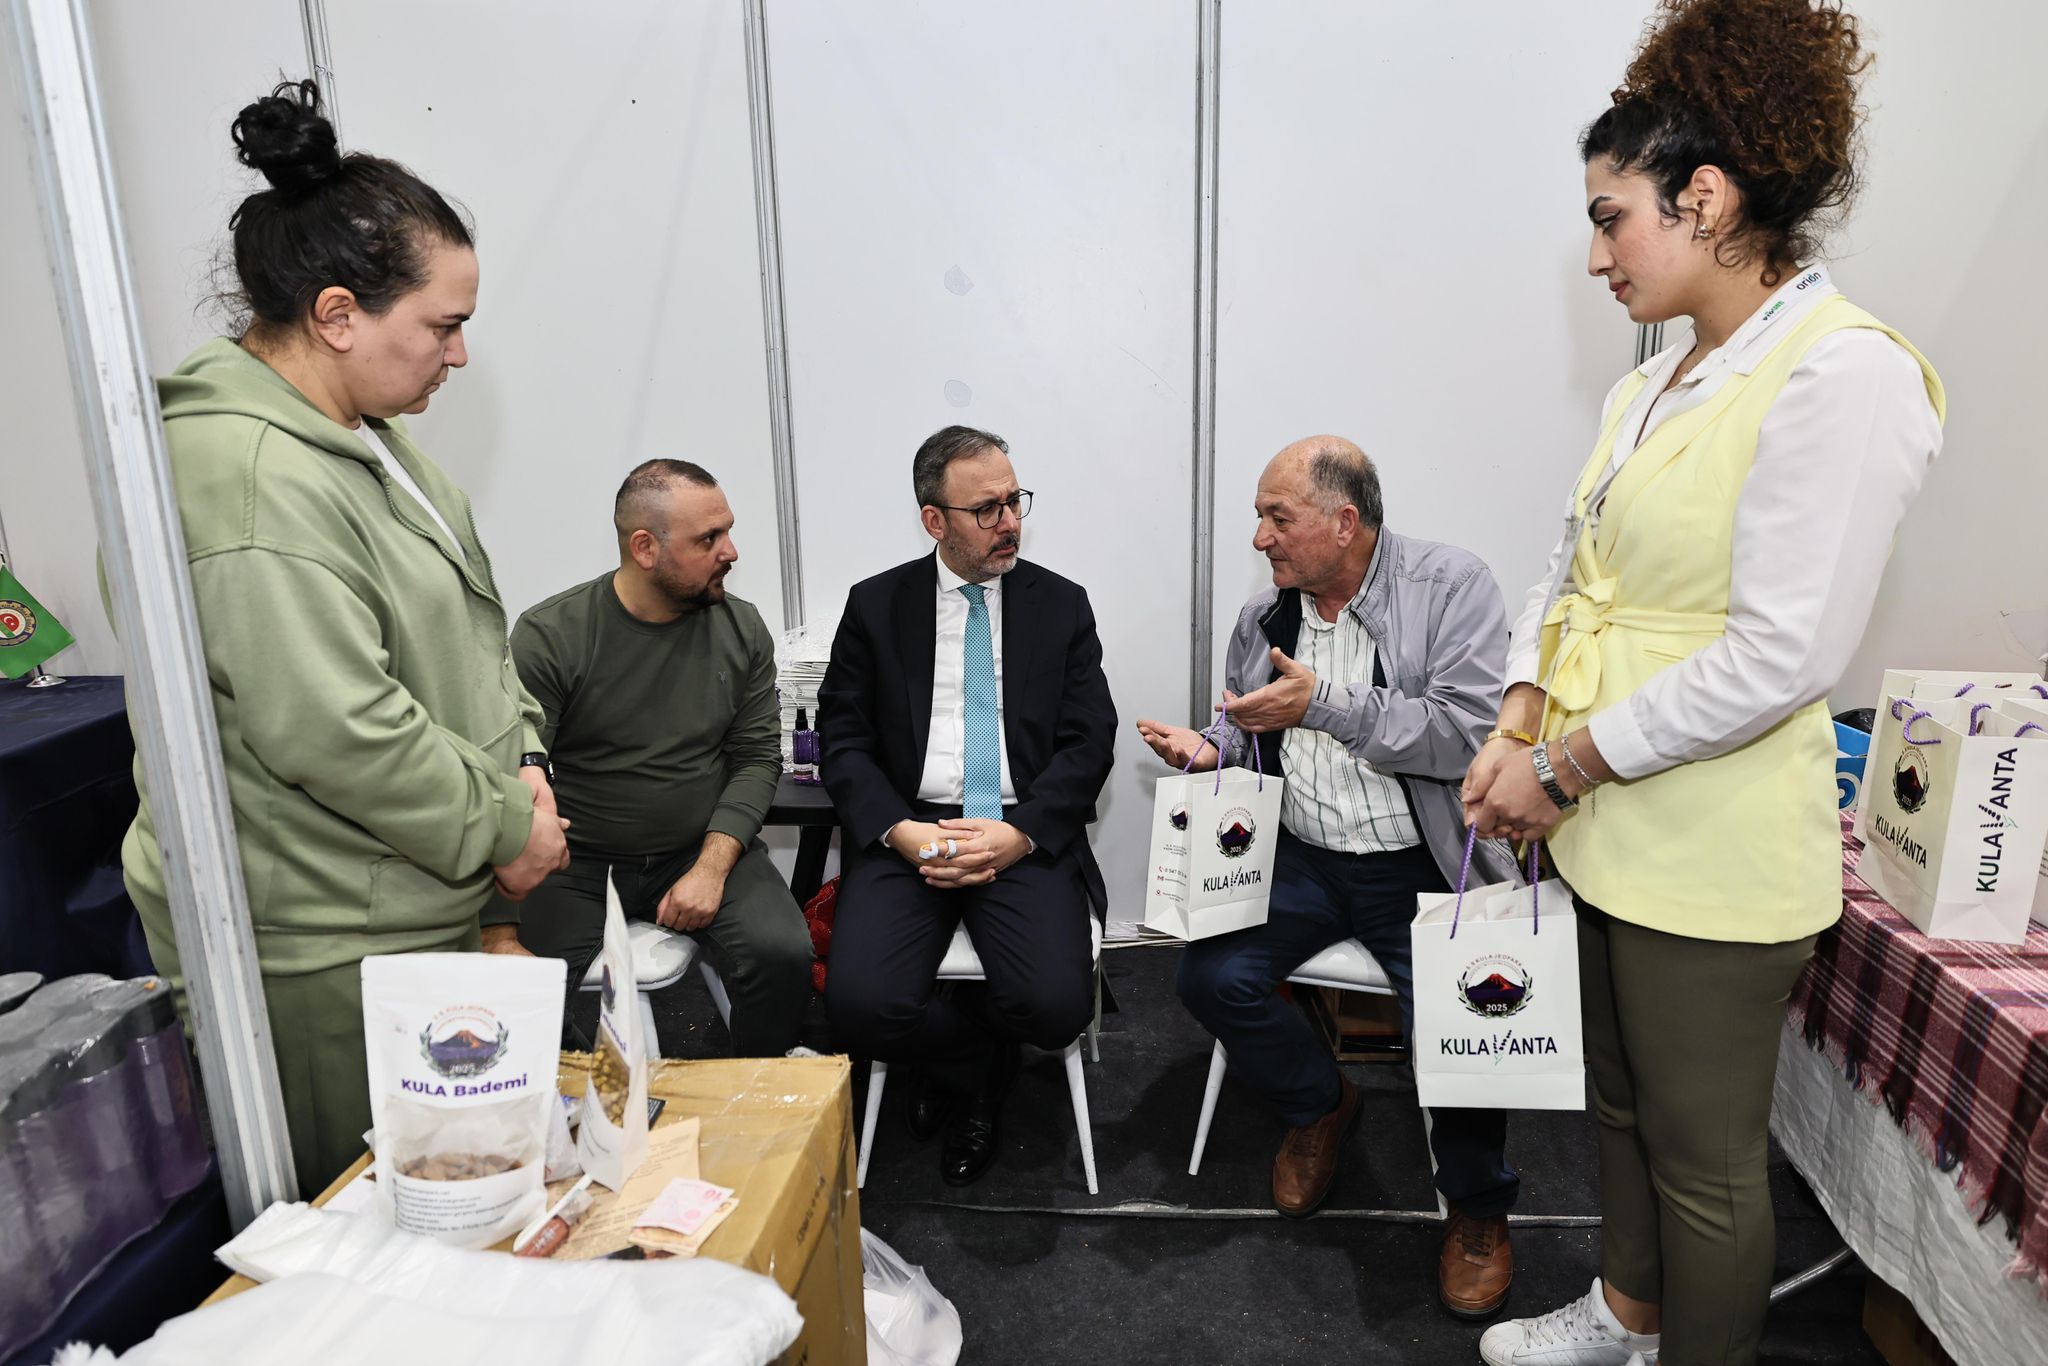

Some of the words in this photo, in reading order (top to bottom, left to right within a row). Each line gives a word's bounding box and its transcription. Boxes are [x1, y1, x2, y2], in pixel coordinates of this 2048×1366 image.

[1486, 1003, 1508, 1012] 2025
[401, 1078, 446, 1097] KULA
[454, 1073, 528, 1097] Bademi
